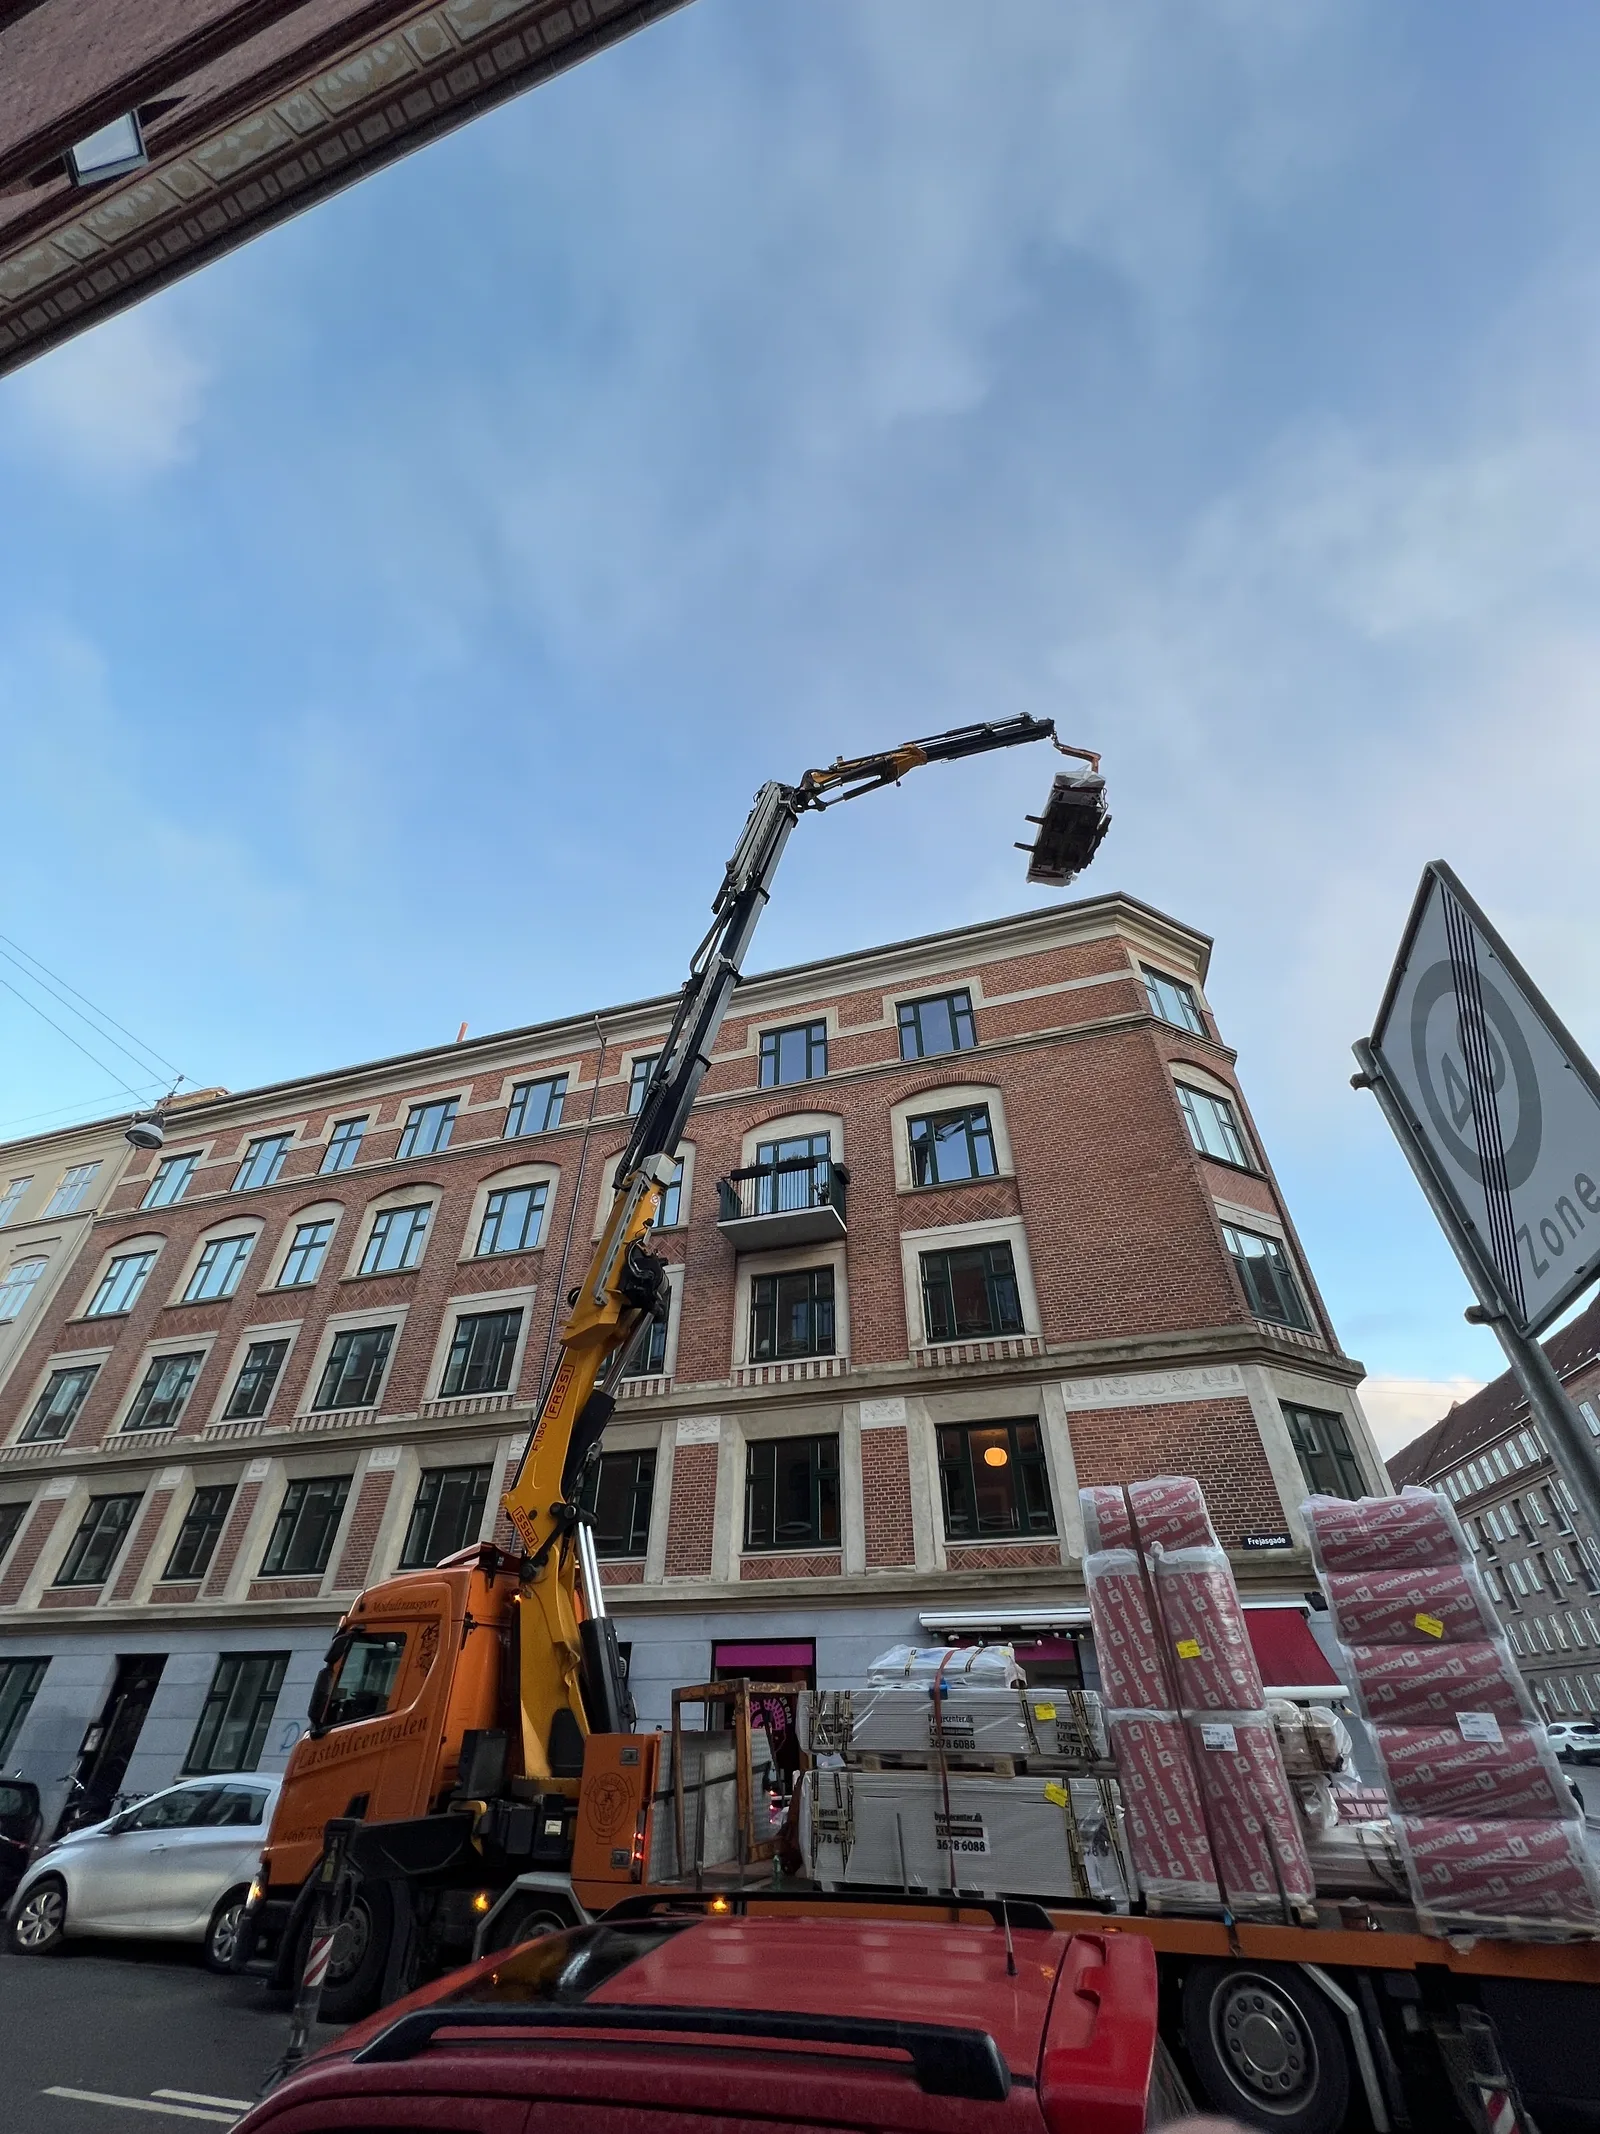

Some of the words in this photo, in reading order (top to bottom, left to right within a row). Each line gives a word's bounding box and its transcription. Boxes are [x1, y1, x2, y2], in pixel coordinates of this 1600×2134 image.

[1515, 1172, 1600, 1280] Zone
[548, 1367, 573, 1415] FASSI
[532, 1422, 548, 1452] F1150
[513, 1510, 537, 1545] FASSI
[1247, 1536, 1286, 1546] Frejasgade
[1373, 1571, 1424, 1593] ROCKWOOL
[1426, 1575, 1465, 1595] CKWOOL
[1120, 1574, 1147, 1620] ROCKWOO
[1361, 1599, 1411, 1622] ROCKWOOL
[1118, 1607, 1147, 1658] ROCKWOOL
[1204, 1614, 1235, 1667] OCKWOOL
[1120, 1649, 1151, 1704] ROCKWOOL
[1358, 1658, 1405, 1680] ROCKWOO
[1396, 1667, 1449, 1693] ROCKWOOL
[1212, 1664, 1238, 1708] CKWOOL
[928, 1713, 974, 1725] byecenter.dk
[296, 1713, 428, 1769] Lastbilcentralen
[953, 1739, 976, 1750] 6088
[1057, 1743, 1081, 1756] 3678
[1388, 1734, 1443, 1762] ROCKWOOL
[1140, 1745, 1171, 1807] ROCKWOOL
[934, 1811, 983, 1823] bygecenter.dk
[961, 1840, 986, 1852] 6088
[1411, 1833, 1460, 1857] ROCKWOO
